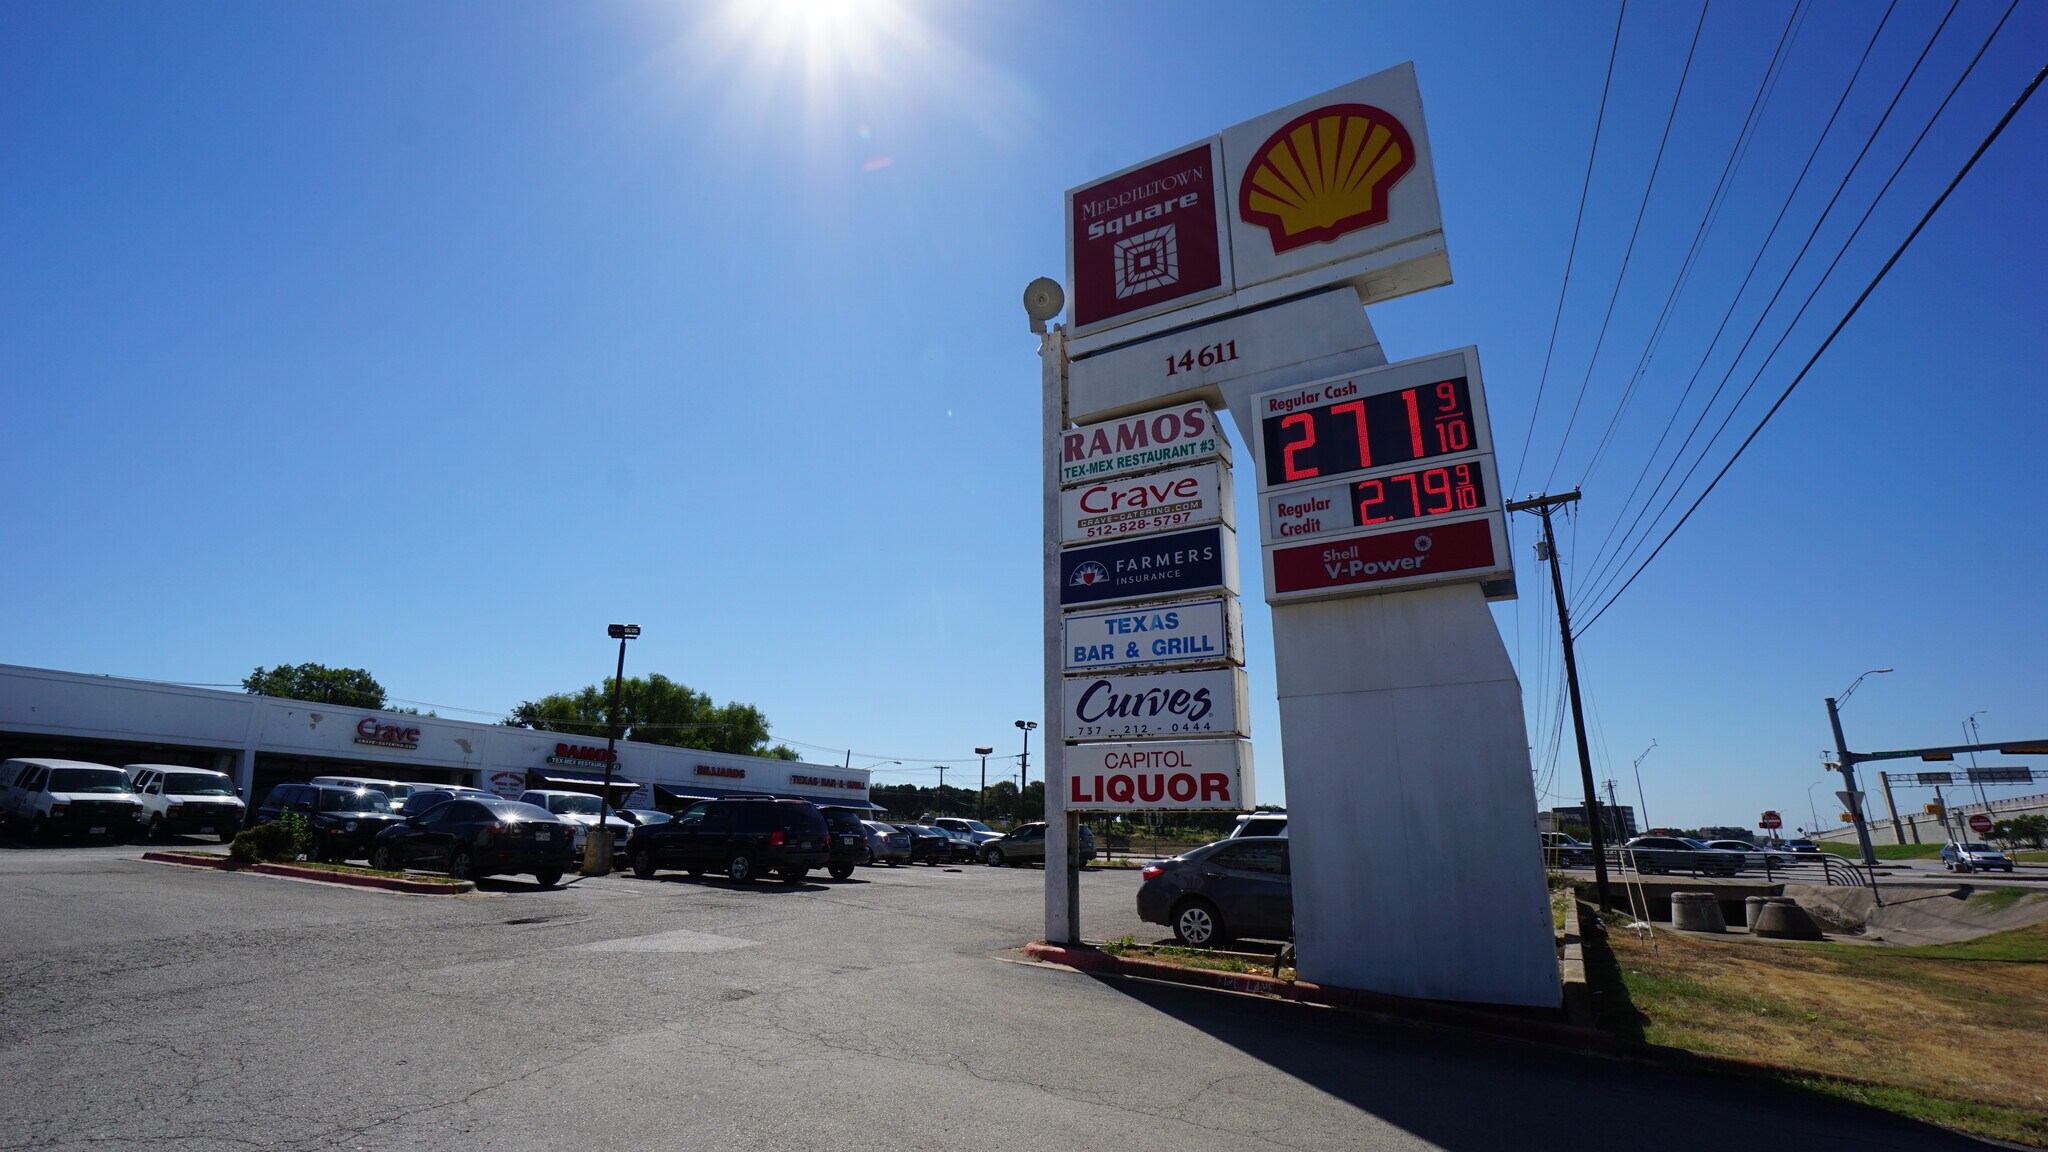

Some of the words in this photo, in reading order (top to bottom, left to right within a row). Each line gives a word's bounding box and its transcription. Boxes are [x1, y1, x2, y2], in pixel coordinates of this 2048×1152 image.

[1081, 166, 1203, 220] MERRILLTOWN
[1088, 192, 1198, 241] Square
[1166, 339, 1240, 377] 14611
[1269, 391, 1320, 412] Regular
[1324, 381, 1358, 400] Cash
[1064, 407, 1206, 463] RAMOS
[1064, 459, 1114, 480] TEX-MEX
[1116, 442, 1197, 469] RESTAURANT
[1200, 439, 1215, 453] #3
[1079, 477, 1199, 514] Crave
[1278, 497, 1331, 519] Regular
[1080, 501, 1200, 528] CRAVE-CATERING.COM
[1087, 511, 1192, 537] 512-828-5797
[1280, 518, 1321, 537] Credit
[1116, 546, 1213, 573] FARMERS
[1322, 545, 1359, 562] Shell
[1116, 569, 1181, 585] INSURANCE
[1324, 555, 1426, 580] V-Power
[1105, 612, 1179, 635] TEXAS
[1074, 644, 1114, 662] BAR
[1125, 641, 1140, 658] &
[1151, 635, 1215, 656] GRILL
[1076, 680, 1212, 723] Curves
[357, 717, 421, 742] Crave
[577, 759, 609, 768] RESTAURA
[694, 765, 746, 779] BILLIARDS
[1104, 751, 1193, 769] CAPITOL
[791, 775, 818, 785] TEXAS
[846, 780, 867, 790] GRILL
[1071, 773, 1231, 804] LIQUOR
